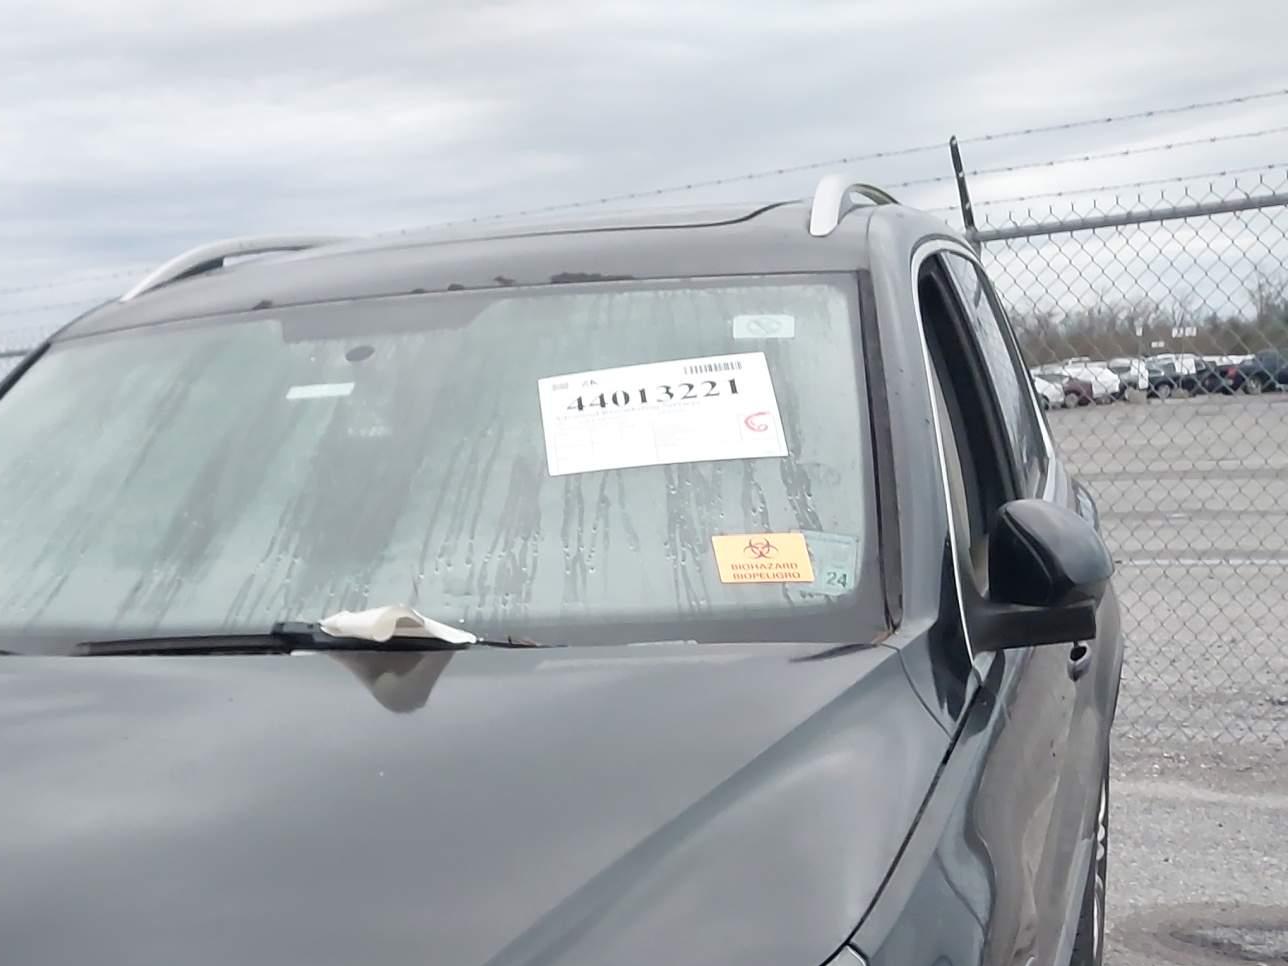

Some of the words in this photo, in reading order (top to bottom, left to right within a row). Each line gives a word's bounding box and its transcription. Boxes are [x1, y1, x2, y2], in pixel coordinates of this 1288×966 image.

[567, 378, 740, 412] 44013221
[730, 562, 799, 571] BIOHAZARD
[732, 571, 802, 581] BIOPELIGRO
[827, 572, 848, 588] 24
